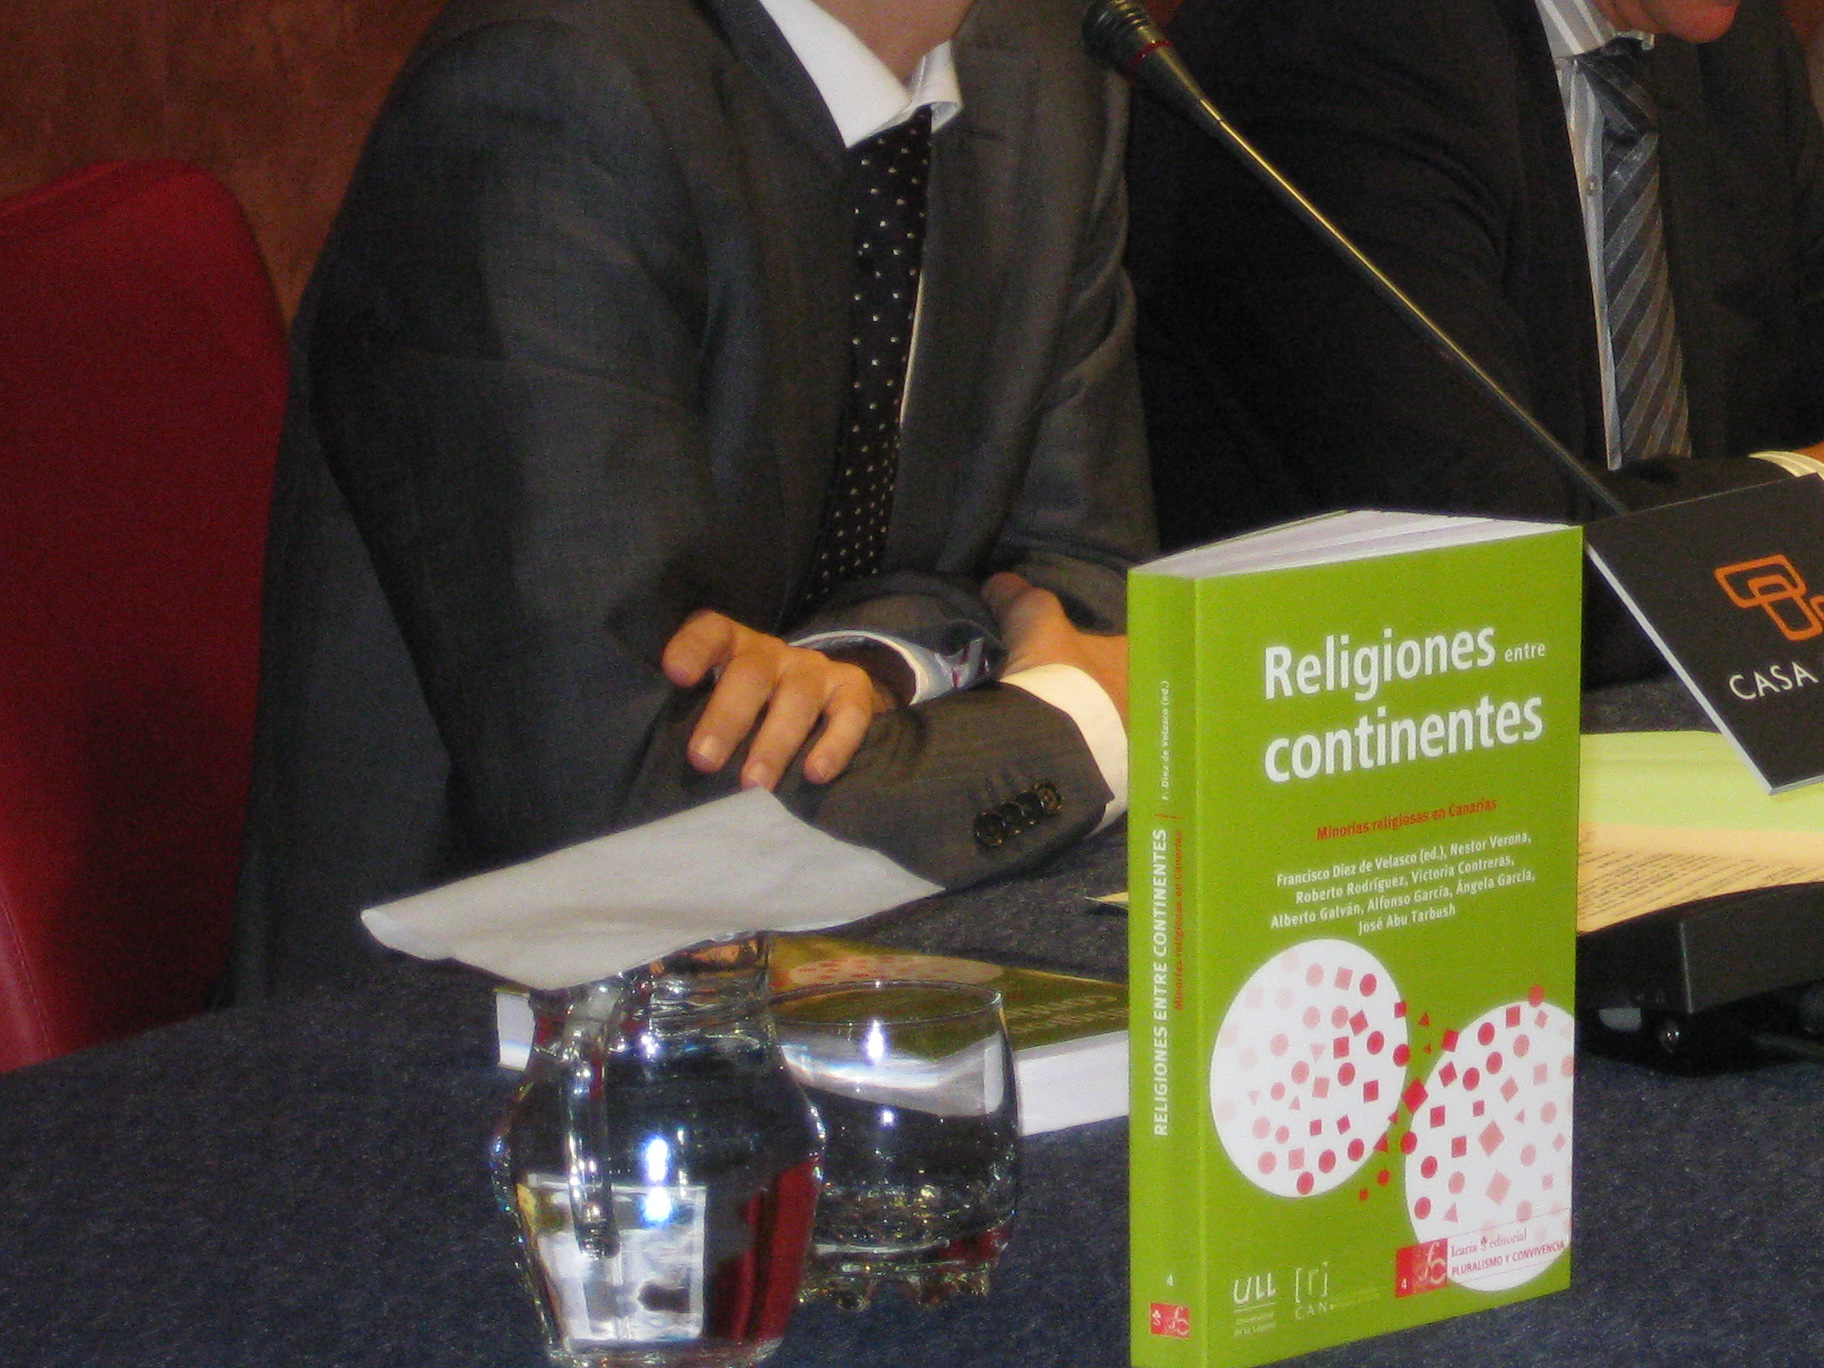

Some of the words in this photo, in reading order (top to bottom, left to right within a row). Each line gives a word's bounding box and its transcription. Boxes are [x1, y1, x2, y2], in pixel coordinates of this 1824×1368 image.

[1264, 627, 1497, 702] Religiones
[1504, 641, 1546, 663] entre
[1728, 661, 1820, 700] CASA
[1264, 695, 1545, 783] continentes
[1448, 799, 1498, 817] Canarias
[1276, 868, 1330, 888] Francisco
[1358, 858, 1373, 874] de
[1374, 853, 1418, 870] Velasco
[1489, 831, 1532, 849] Verona,
[1295, 886, 1344, 904] Roberto
[1411, 864, 1455, 885] Victoria
[1457, 854, 1515, 875] Contreras,
[1152, 829, 1168, 957] CONTINENTES
[1270, 909, 1317, 929] Alberto
[1319, 900, 1364, 921] Galván,
[1367, 893, 1412, 913] Alfonso
[1455, 877, 1495, 895] Ángela
[1497, 867, 1536, 887] García,
[1358, 916, 1384, 936] José
[1386, 911, 1408, 929] Abu
[1410, 902, 1456, 923] Tarbush
[1153, 962, 1168, 1021] ENTRE
[1153, 1026, 1169, 1136] RELIGIONES
[1451, 1255, 1503, 1276] PLURALISMO
[1512, 1239, 1565, 1263] CONVIVENCIA
